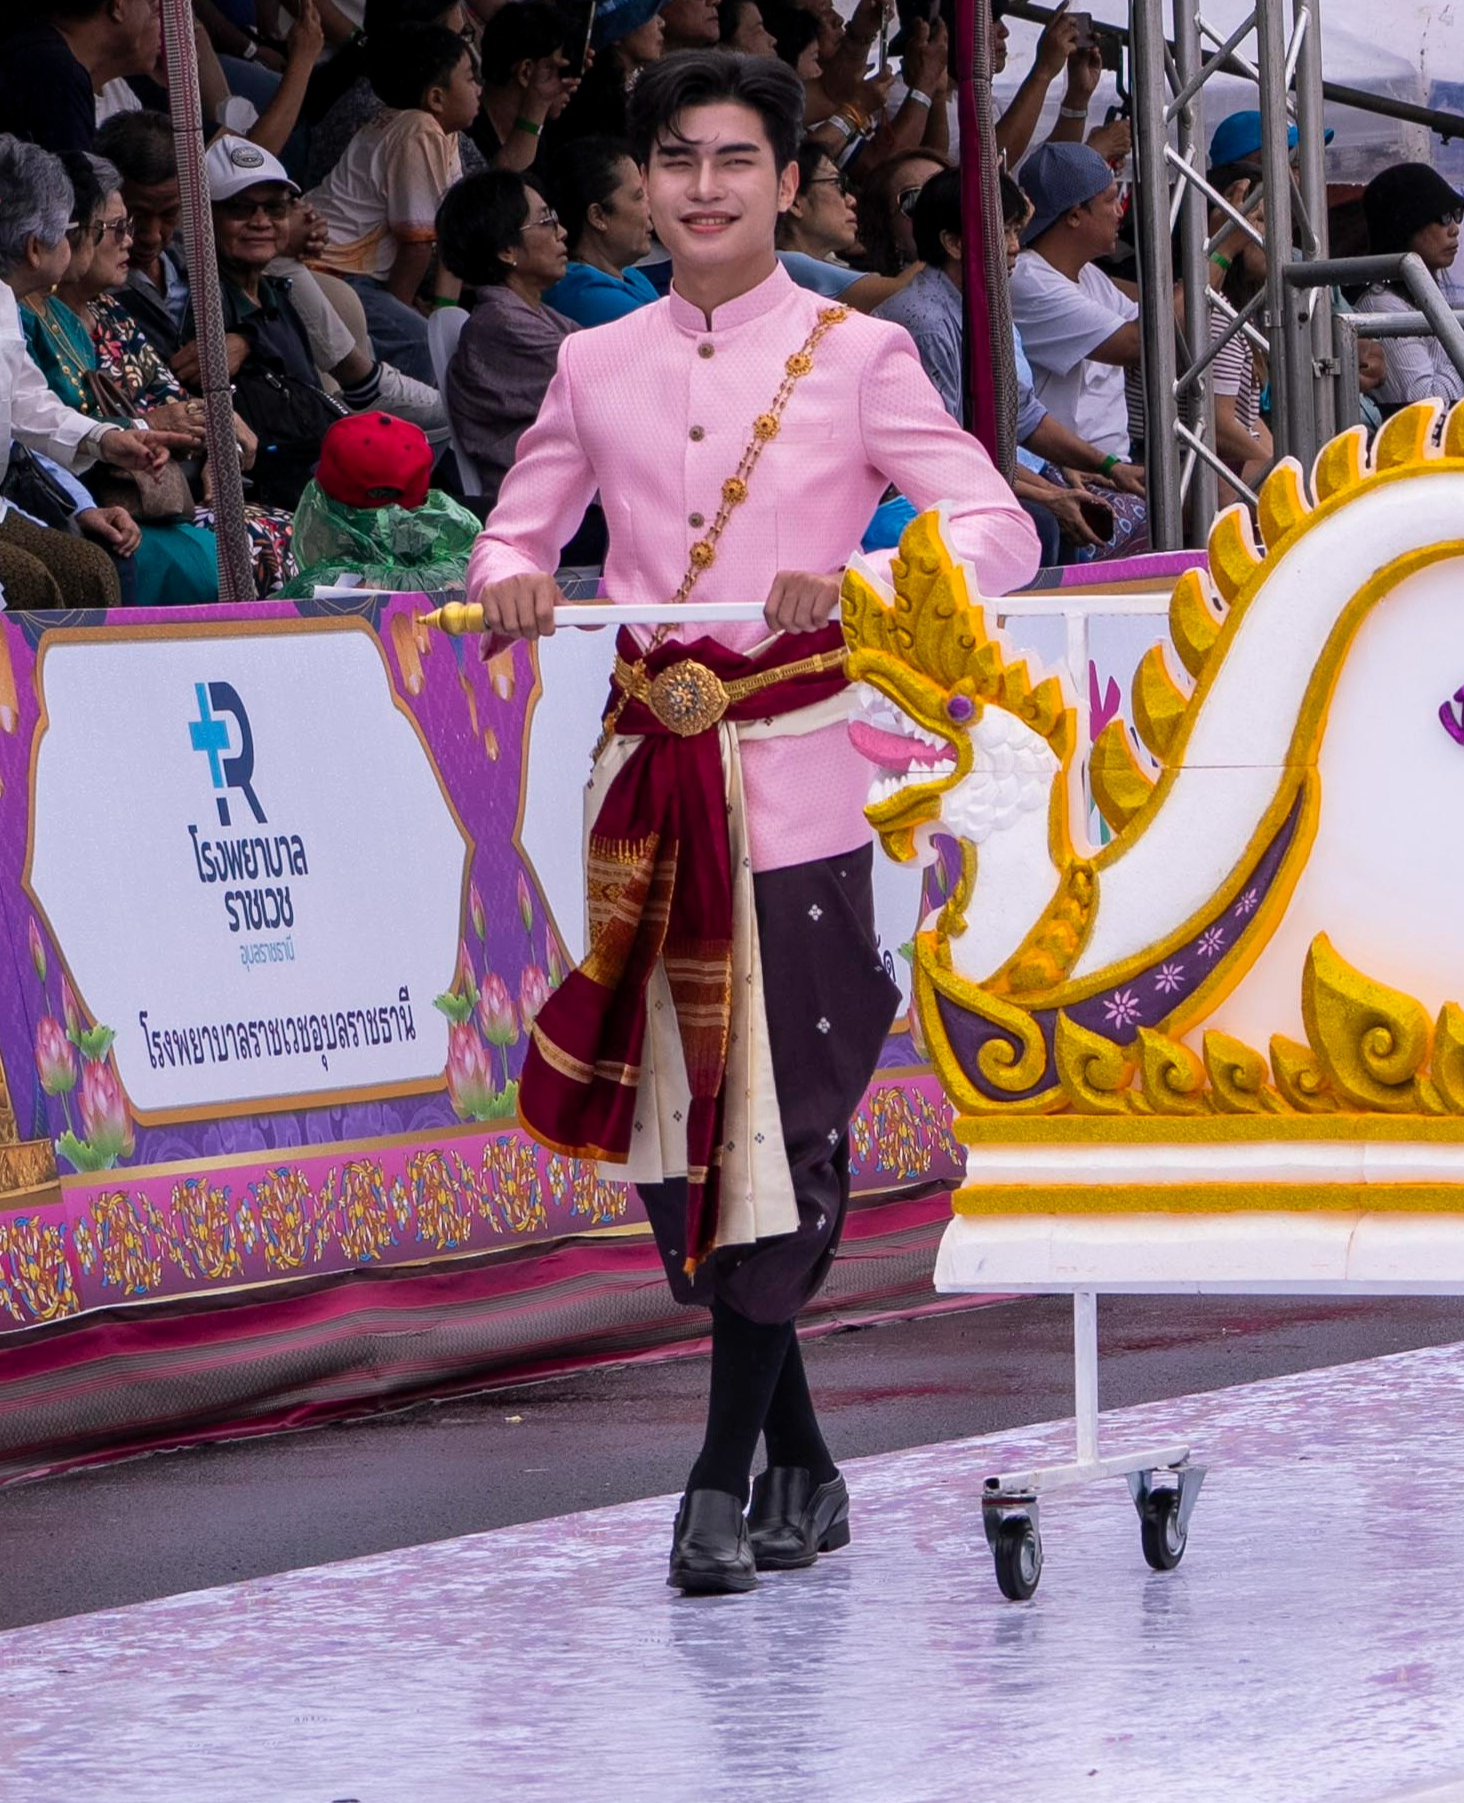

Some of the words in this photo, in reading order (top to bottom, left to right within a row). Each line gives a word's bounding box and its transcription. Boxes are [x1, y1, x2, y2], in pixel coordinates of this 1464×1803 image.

[187, 824, 310, 884] โรงพยาบาล
[224, 886, 295, 933] ราชเวช
[138, 985, 417, 1072] โรงพยาบาลราชเวชอุบลราชธานี
